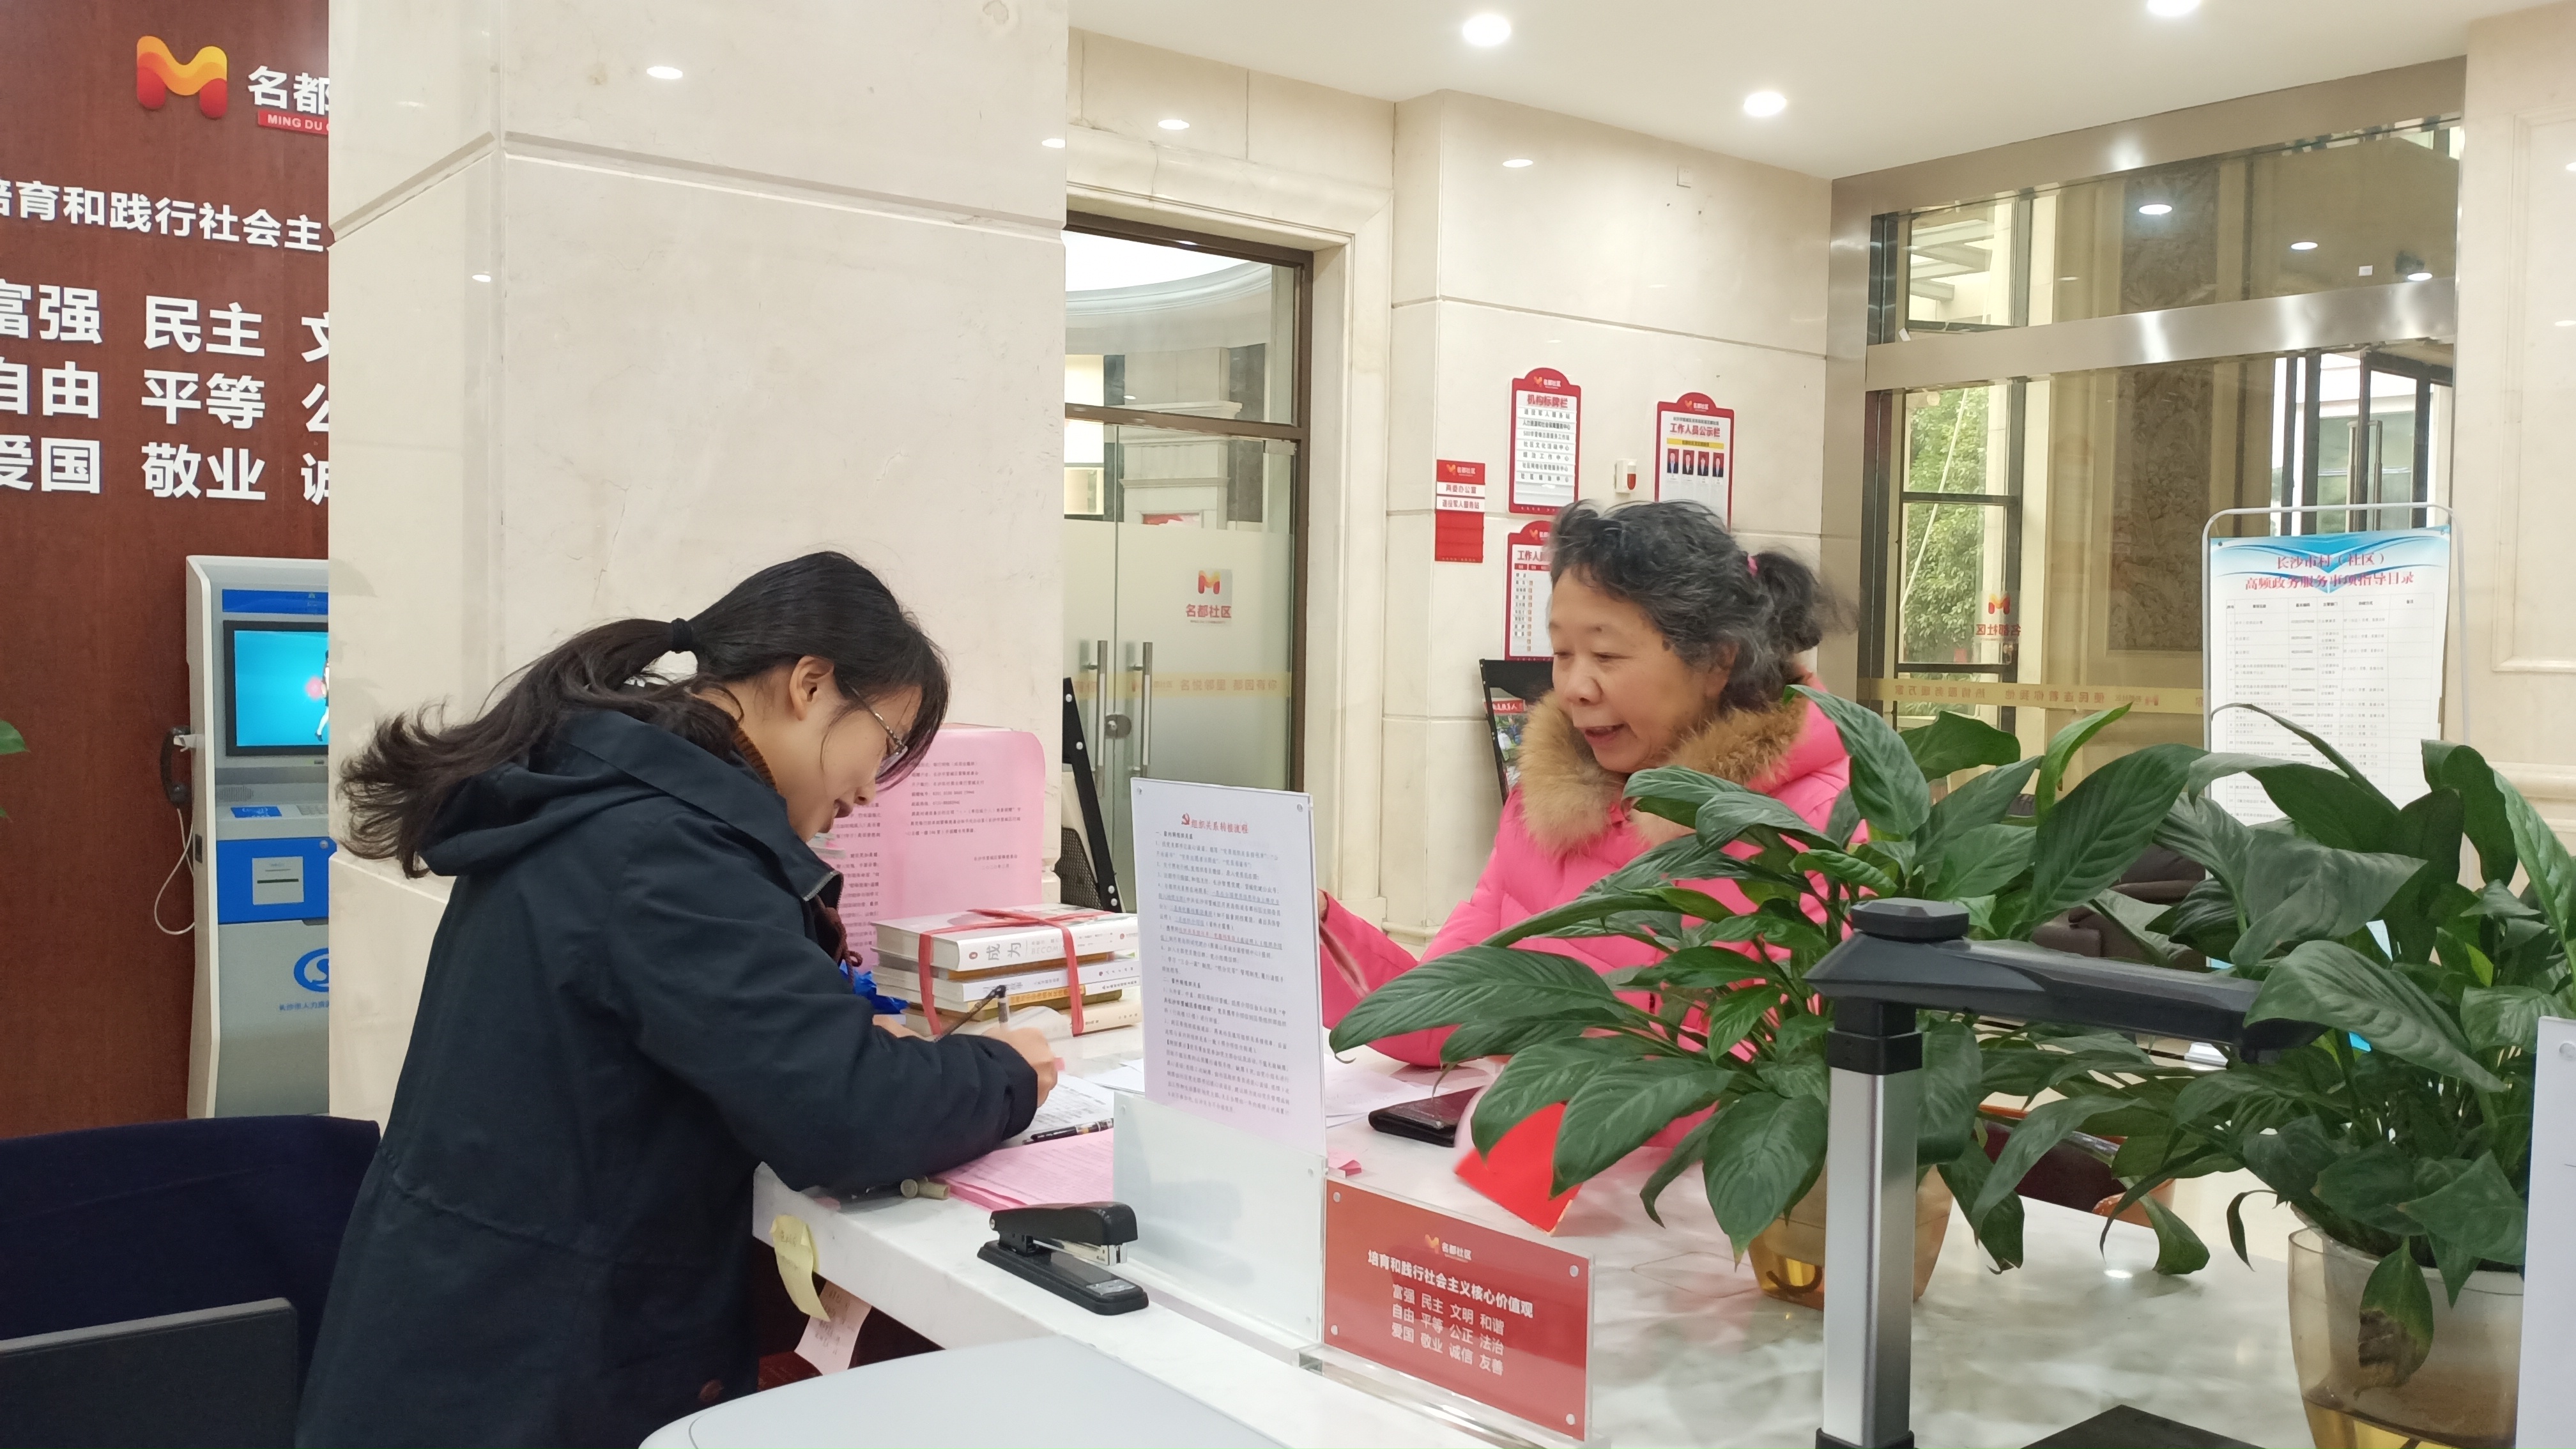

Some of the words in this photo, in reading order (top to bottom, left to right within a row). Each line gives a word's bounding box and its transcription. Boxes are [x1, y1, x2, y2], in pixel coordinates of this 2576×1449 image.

[247, 66, 329, 116] 名都
[267, 114, 300, 129] MING
[304, 116, 323, 132] DU
[0, 179, 324, 253] 育和践行社会主
[144, 295, 266, 357] 民主
[141, 369, 266, 430] 平等
[1527, 394, 1568, 408] 机构标牌栏
[1669, 422, 1721, 438] 工作人员公示栏
[141, 442, 266, 501] 敬业
[2278, 553, 2385, 569] 长沙市村（社区）
[2245, 571, 2414, 590] 高频政务服务事项指导目录
[1185, 604, 1232, 618] 名都社区
[986, 942, 1022, 961] 成为
[1031, 943, 1063, 955] BECOMI
[1441, 1241, 1472, 1261] 名都社区
[1368, 1249, 1534, 1319] 培育和践行社会主义核心价值观
[1392, 1284, 1415, 1305] 富强
[1421, 1292, 1444, 1314] 民主
[1450, 1304, 1474, 1324] 文明
[1480, 1314, 1505, 1336] 和谐
[1392, 1303, 1414, 1324] 自由
[1420, 1312, 1443, 1334] 平等
[1449, 1324, 1474, 1345] 公正
[1479, 1333, 1504, 1356] 法治
[1392, 1321, 1414, 1343] 爱国
[1420, 1332, 1443, 1354] 敬业
[1449, 1343, 1473, 1365] 诚信
[1479, 1354, 1504, 1376] 友善
